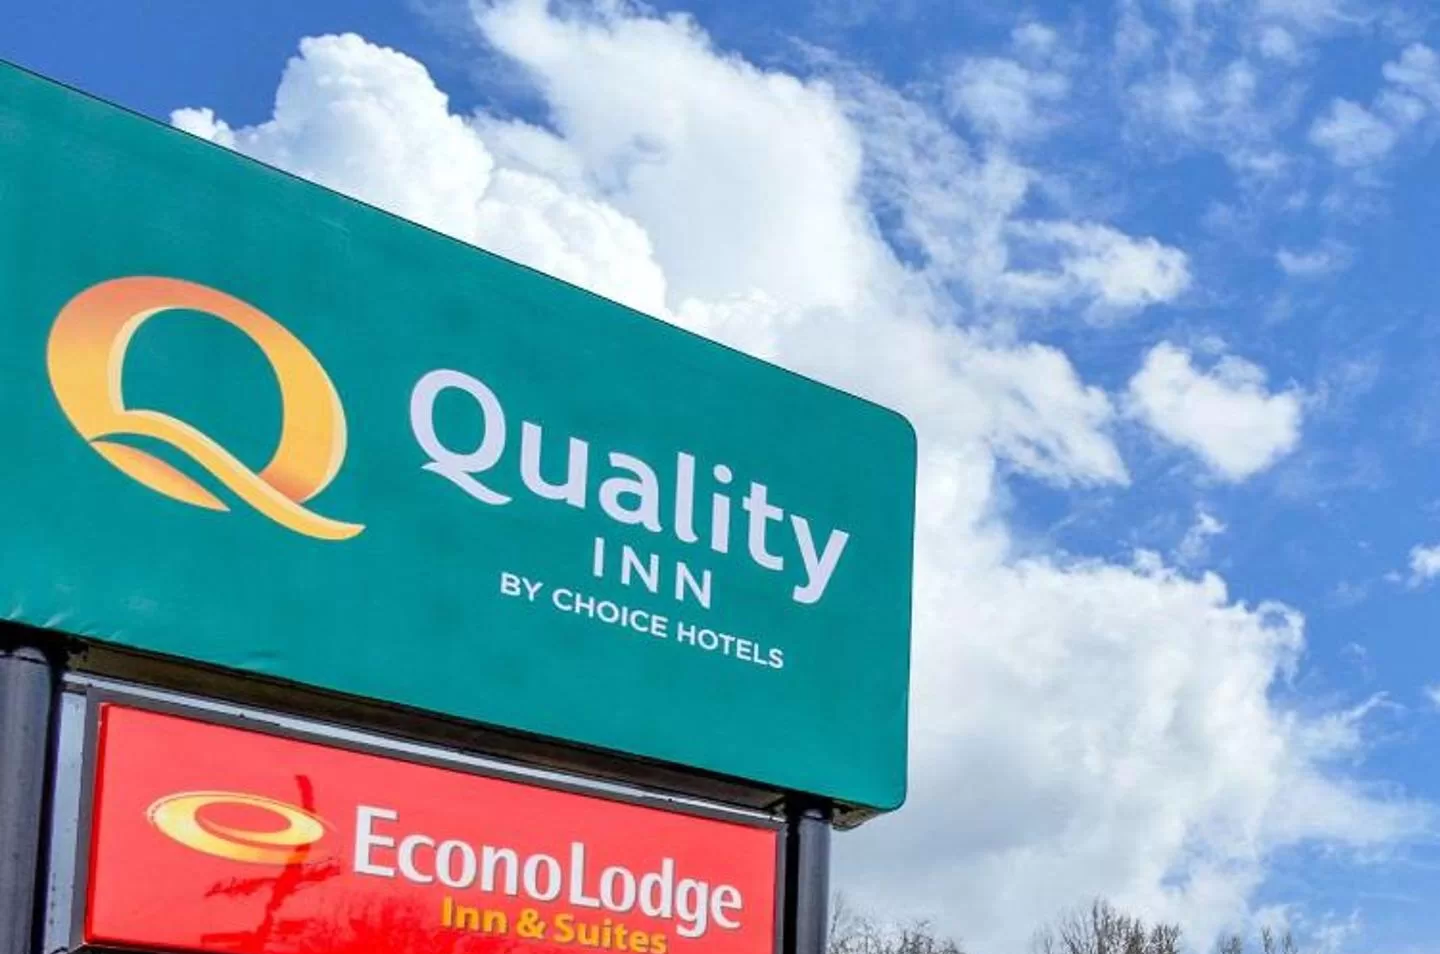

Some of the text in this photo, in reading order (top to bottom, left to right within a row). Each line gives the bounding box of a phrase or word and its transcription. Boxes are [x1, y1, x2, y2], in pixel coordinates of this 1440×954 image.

[409, 368, 850, 604] Quality
[593, 536, 712, 609] INN
[500, 572, 784, 669] BY CHOICE HOTELS
[441, 895, 508, 935] Inn
[516, 907, 546, 941] &
